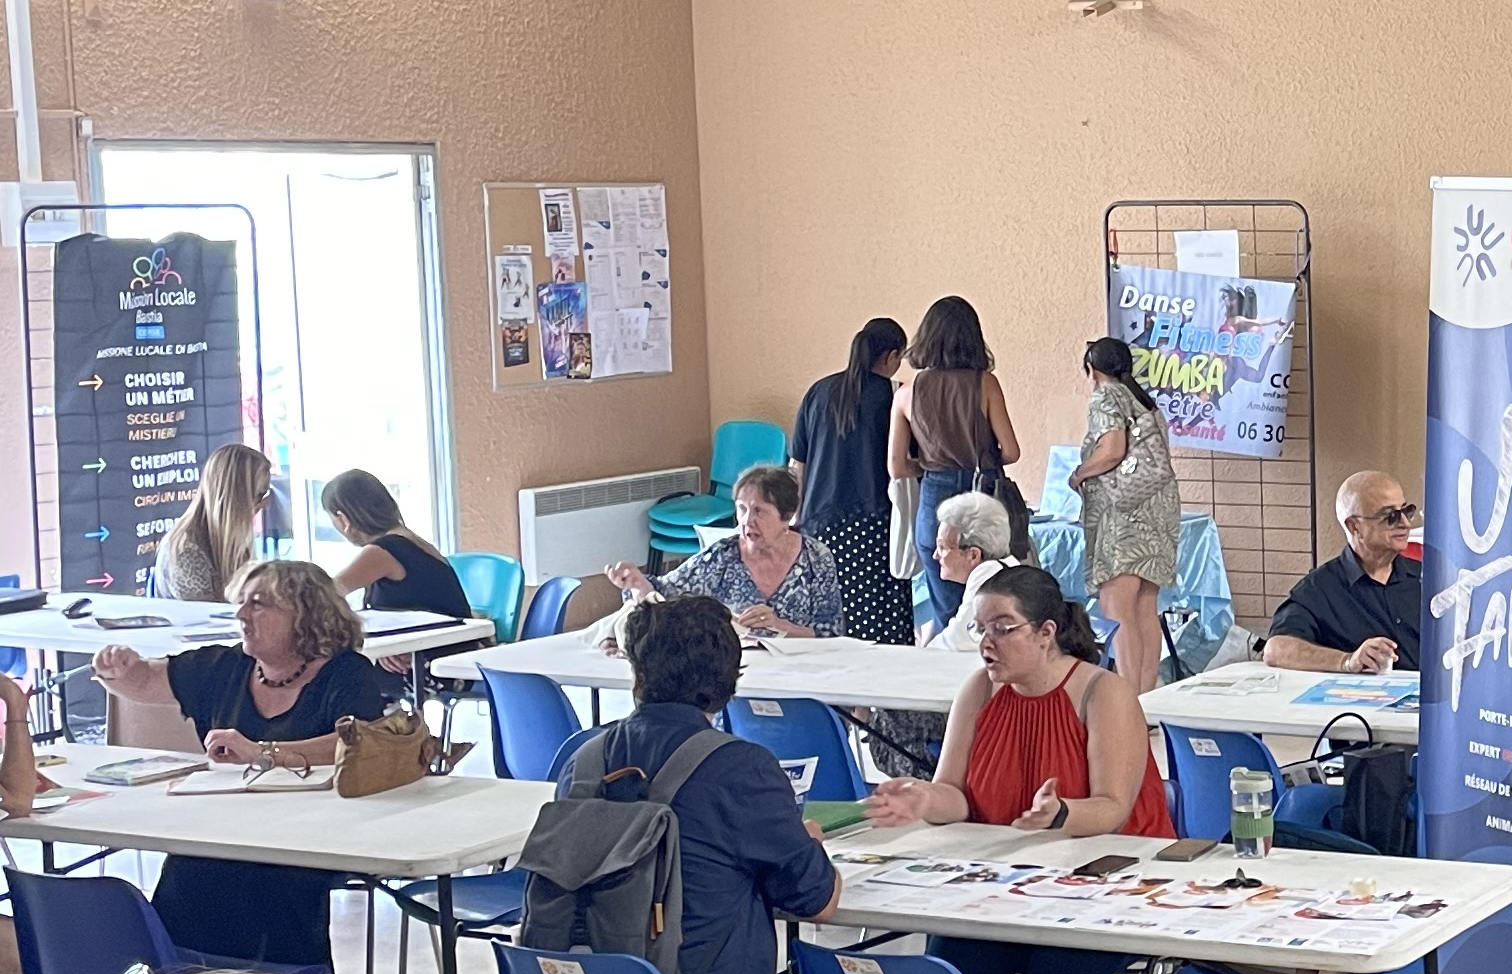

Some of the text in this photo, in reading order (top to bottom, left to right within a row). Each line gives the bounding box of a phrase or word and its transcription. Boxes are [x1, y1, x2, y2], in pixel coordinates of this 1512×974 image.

[155, 287, 197, 306] Locale
[1119, 285, 1196, 316] Danse
[135, 309, 163, 324] Bastia
[1149, 316, 1264, 359] Fitness
[135, 345, 173, 356] LUCALE
[175, 344, 185, 355] DI
[125, 371, 185, 388] CHOISIR
[1129, 349, 1224, 395] ZUMBA
[126, 391, 149, 406] UN
[1237, 421, 1285, 443] 06 30
[130, 450, 197, 471] CHERCHER
[132, 474, 155, 489] UN
[161, 490, 176, 503] UN
[136, 523, 150, 537] SE
[1469, 740, 1501, 759] EXPERT
[1464, 773, 1497, 794] RÉSEAU
[1498, 782, 1511, 796] DE
